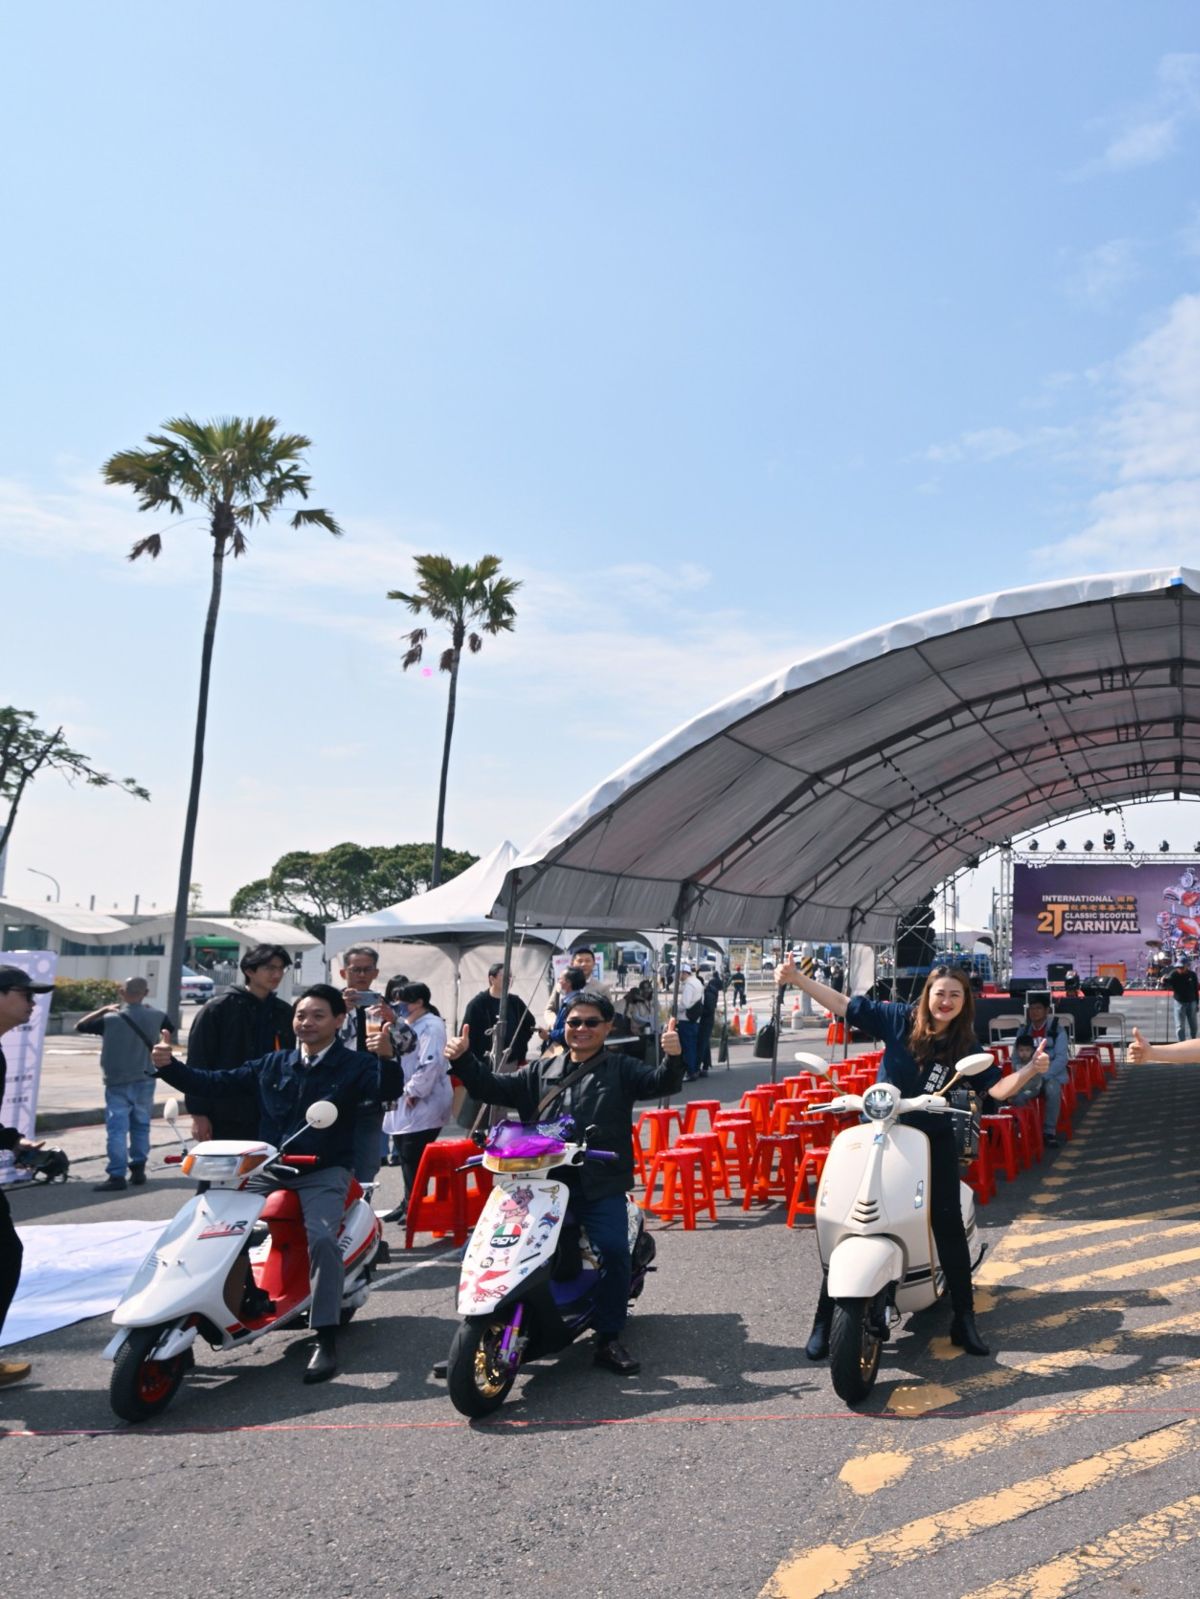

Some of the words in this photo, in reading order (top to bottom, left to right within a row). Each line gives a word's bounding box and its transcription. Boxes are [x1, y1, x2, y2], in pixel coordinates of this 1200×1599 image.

[1042, 895, 1113, 903] INTERNATIONAL
[1037, 903, 1070, 937] 2T
[1063, 920, 1139, 932] CARNIVAL
[490, 1236, 519, 1246] agv
